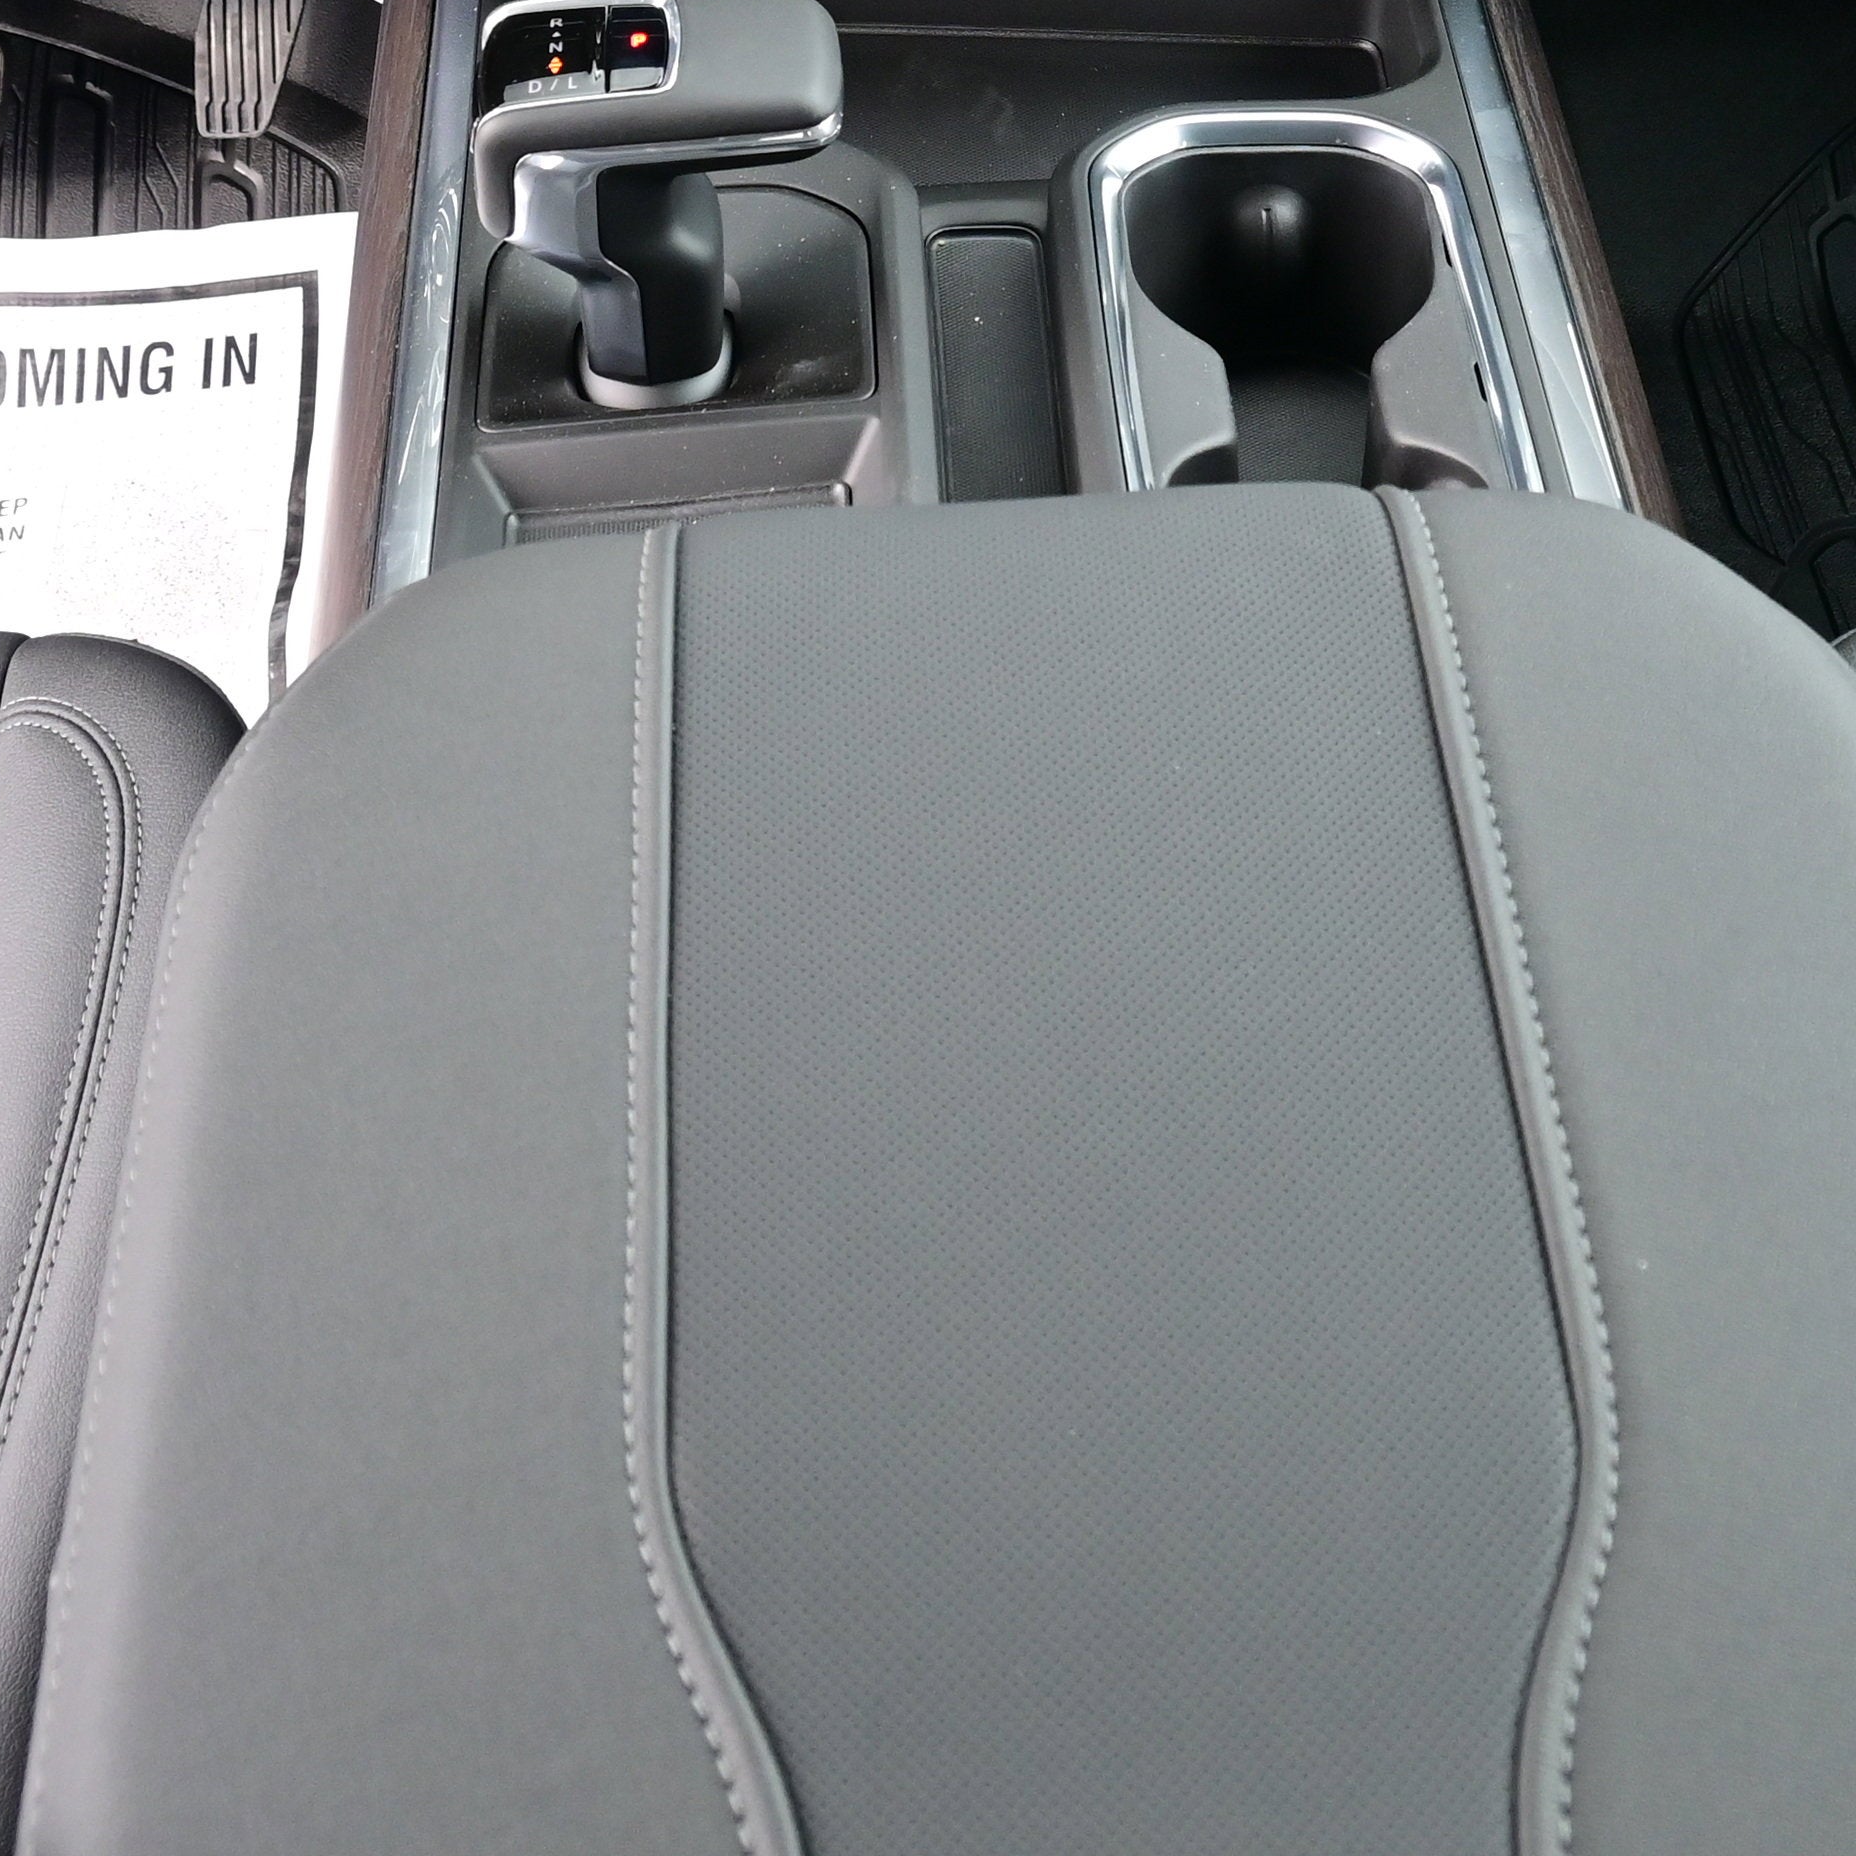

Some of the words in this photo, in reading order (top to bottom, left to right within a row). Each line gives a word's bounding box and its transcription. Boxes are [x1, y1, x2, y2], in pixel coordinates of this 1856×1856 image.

[550, 18, 563, 28] R
[549, 41, 563, 53] N
[630, 33, 647, 48] P
[202, 333, 257, 389] IN
